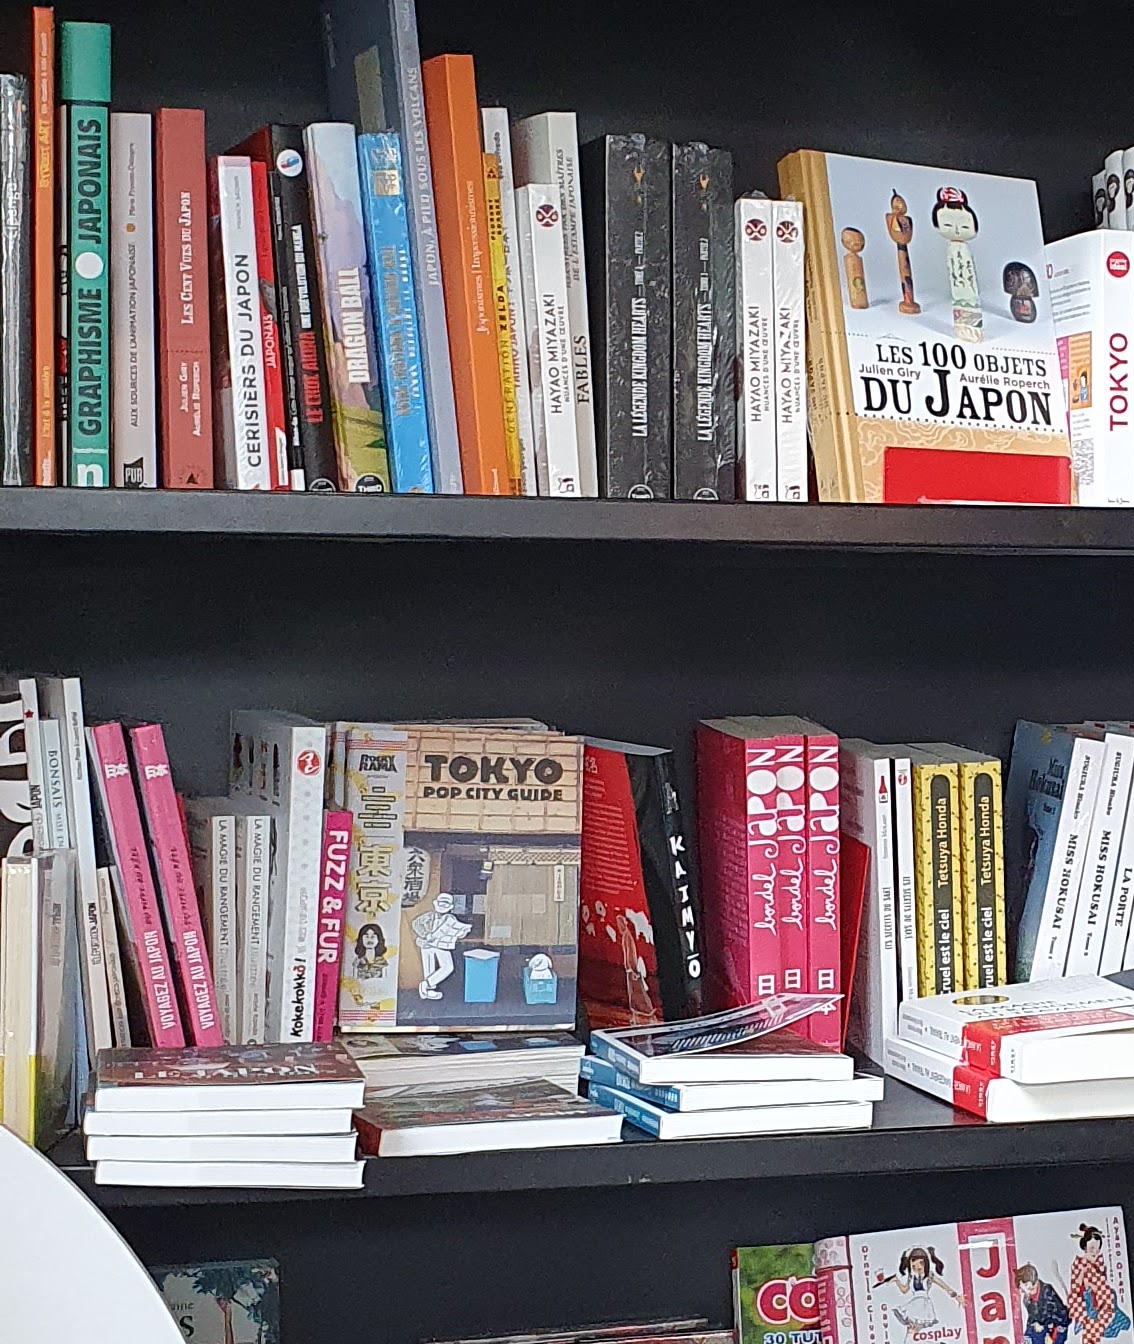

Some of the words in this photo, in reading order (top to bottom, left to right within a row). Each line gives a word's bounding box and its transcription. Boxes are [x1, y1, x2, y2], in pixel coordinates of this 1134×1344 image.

[77, 119, 102, 244] JAPONAIS
[235, 254, 253, 322] JAPON
[337, 268, 362, 308] BALL
[240, 330, 254, 355] DU
[342, 312, 370, 383] DRAGON
[542, 294, 558, 362] MIYAZAKI
[748, 306, 760, 372] MIYAZAKI
[780, 308, 791, 373] MIYAZAKI
[78, 288, 102, 436] GRAPHISME
[574, 335, 589, 403] FABLES
[632, 336, 647, 380] KINGDOM
[698, 341, 711, 384] KINGDOM
[859, 364, 895, 376] Julien
[897, 366, 922, 380] Giry
[959, 371, 1000, 386] Aurélie
[1003, 376, 1050, 390] Roperch
[876, 343, 913, 364] LES
[918, 341, 967, 369] 100
[974, 354, 1047, 378] OBJETS
[547, 367, 562, 414] HAYAO
[751, 377, 761, 421] HAYAO
[781, 378, 792, 423] HAYAO
[861, 376, 912, 415] DU
[925, 368, 1053, 427] JAPON
[1109, 332, 1128, 432] TOKYO
[242, 365, 261, 467] CERISIERS
[424, 756, 564, 785] TOKYO
[424, 786, 461, 800] POP
[466, 787, 503, 800] CITY
[508, 788, 564, 801] GUIDE
[936, 798, 948, 838] Honda
[979, 797, 990, 837] Honda
[324, 830, 348, 891] FUZZ
[938, 841, 950, 887] Tetsuya
[979, 840, 992, 885] Tetsuya
[1065, 834, 1078, 865] MISS
[1099, 830, 1111, 861] MISS
[358, 843, 391, 915] 東京
[1087, 864, 1106, 925] HOKUSAI
[1122, 868, 1132, 883] LA
[219, 886, 229, 945] RANGEMENT
[250, 885, 261, 944] RANGEMENT
[981, 907, 993, 927] ciel
[1052, 869, 1071, 929] HOKUSAI
[1115, 887, 1128, 927] PORTE
[144, 931, 163, 963] JAPON
[183, 931, 202, 963] JAPON
[318, 918, 339, 963] FUR
[940, 933, 950, 943] le
[941, 946, 950, 964] est
[983, 930, 992, 941] le
[984, 944, 994, 962] est
[151, 966, 165, 979] AU
[190, 966, 204, 979] AU
[155, 982, 176, 1029] VOYAGEZ
[193, 982, 215, 1029] VOYAGEZ
[913, 1326, 962, 1342] cosplay
